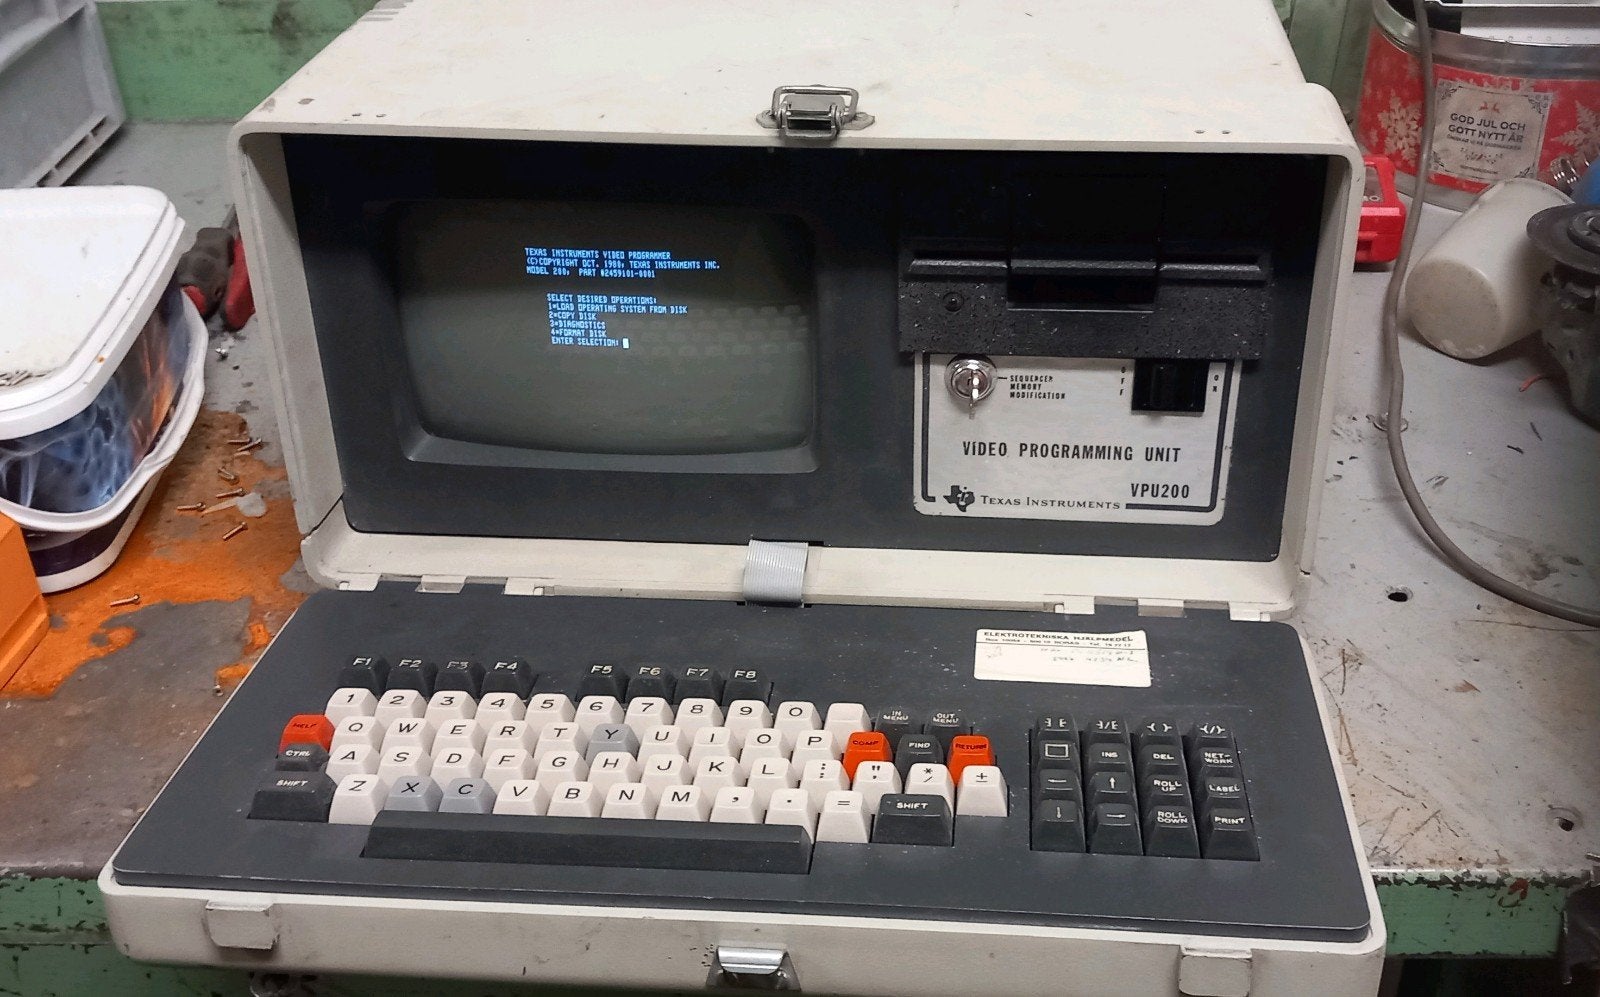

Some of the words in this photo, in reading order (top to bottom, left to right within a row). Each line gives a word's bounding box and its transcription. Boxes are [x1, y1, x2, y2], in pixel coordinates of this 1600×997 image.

[1450, 113, 1475, 125] GOD
[1477, 119, 1497, 129] JUL
[1500, 121, 1526, 131] OCH
[1448, 124, 1476, 136] GOTT
[1478, 131, 1506, 141] NYTT
[1508, 132, 1524, 143] ÅR
[525, 248, 547, 257] TEXAS
[552, 249, 599, 259] INSTRUMENTS
[603, 251, 625, 259] VIDEO
[629, 252, 670, 260] PROGRAMMER
[630, 261, 651, 269] TEXAS
[655, 261, 700, 269] INSTRUMENTS
[705, 261, 720, 269] INC.
[527, 266, 549, 275] MODEL
[579, 268, 596, 277] PART
[547, 293, 573, 302] SELECT
[577, 295, 607, 303] DESIRED
[578, 304, 617, 312] OPERATING
[621, 305, 646, 313] SYSTEM
[650, 306, 667, 314] FROM
[670, 306, 688, 314] DISK
[589, 330, 607, 338] DISK
[552, 336, 574, 345] ENTER
[962, 441, 1008, 457] VIDEO
[1019, 443, 1133, 461] PROGRAMMING
[1145, 447, 1181, 462] UNIT
[1130, 483, 1190, 499] VPU200
[980, 495, 1021, 506] TEXAS
[1026, 497, 1120, 510] INSTRUMENTS
[983, 631, 1069, 640] ELEKTROTEKNISKA
[352, 657, 372, 666] F1
[398, 659, 422, 668] F2
[446, 661, 469, 669] F3
[493, 661, 518, 671] F4
[590, 665, 612, 674] F5
[638, 667, 661, 676] F6
[686, 668, 709, 677] F7
[734, 670, 757, 679] F8
[347, 694, 355, 703] 1
[389, 695, 405, 705] 2
[440, 696, 454, 706] 3
[491, 698, 505, 708] 4
[541, 699, 554, 709] 5
[589, 701, 603, 711] 6
[641, 702, 654, 712] 7
[690, 704, 704, 714] 8
[740, 706, 753, 716] 9
[348, 723, 364, 732] Q
[398, 723, 418, 733] W
[450, 724, 467, 734] E
[500, 726, 516, 736] R
[554, 728, 567, 738] T
[604, 729, 619, 740] Y
[655, 731, 669, 741] U
[807, 736, 822, 746] P
[340, 751, 356, 760] A
[393, 752, 410, 762] S
[446, 753, 462, 764] D
[498, 755, 515, 765] F
[552, 757, 567, 767] G
[602, 758, 620, 769] H
[657, 760, 673, 771] J
[708, 762, 725, 772] K
[762, 764, 775, 775] L
[348, 781, 367, 791] Z
[401, 782, 420, 793] X
[458, 784, 473, 795] C
[1209, 785, 1240, 793] LABEL
[513, 786, 529, 797] V
[565, 788, 581, 799] B
[618, 789, 635, 800] N
[671, 791, 691, 802] M
[896, 802, 929, 810] SHIFT
[1215, 816, 1246, 825] PRINT
